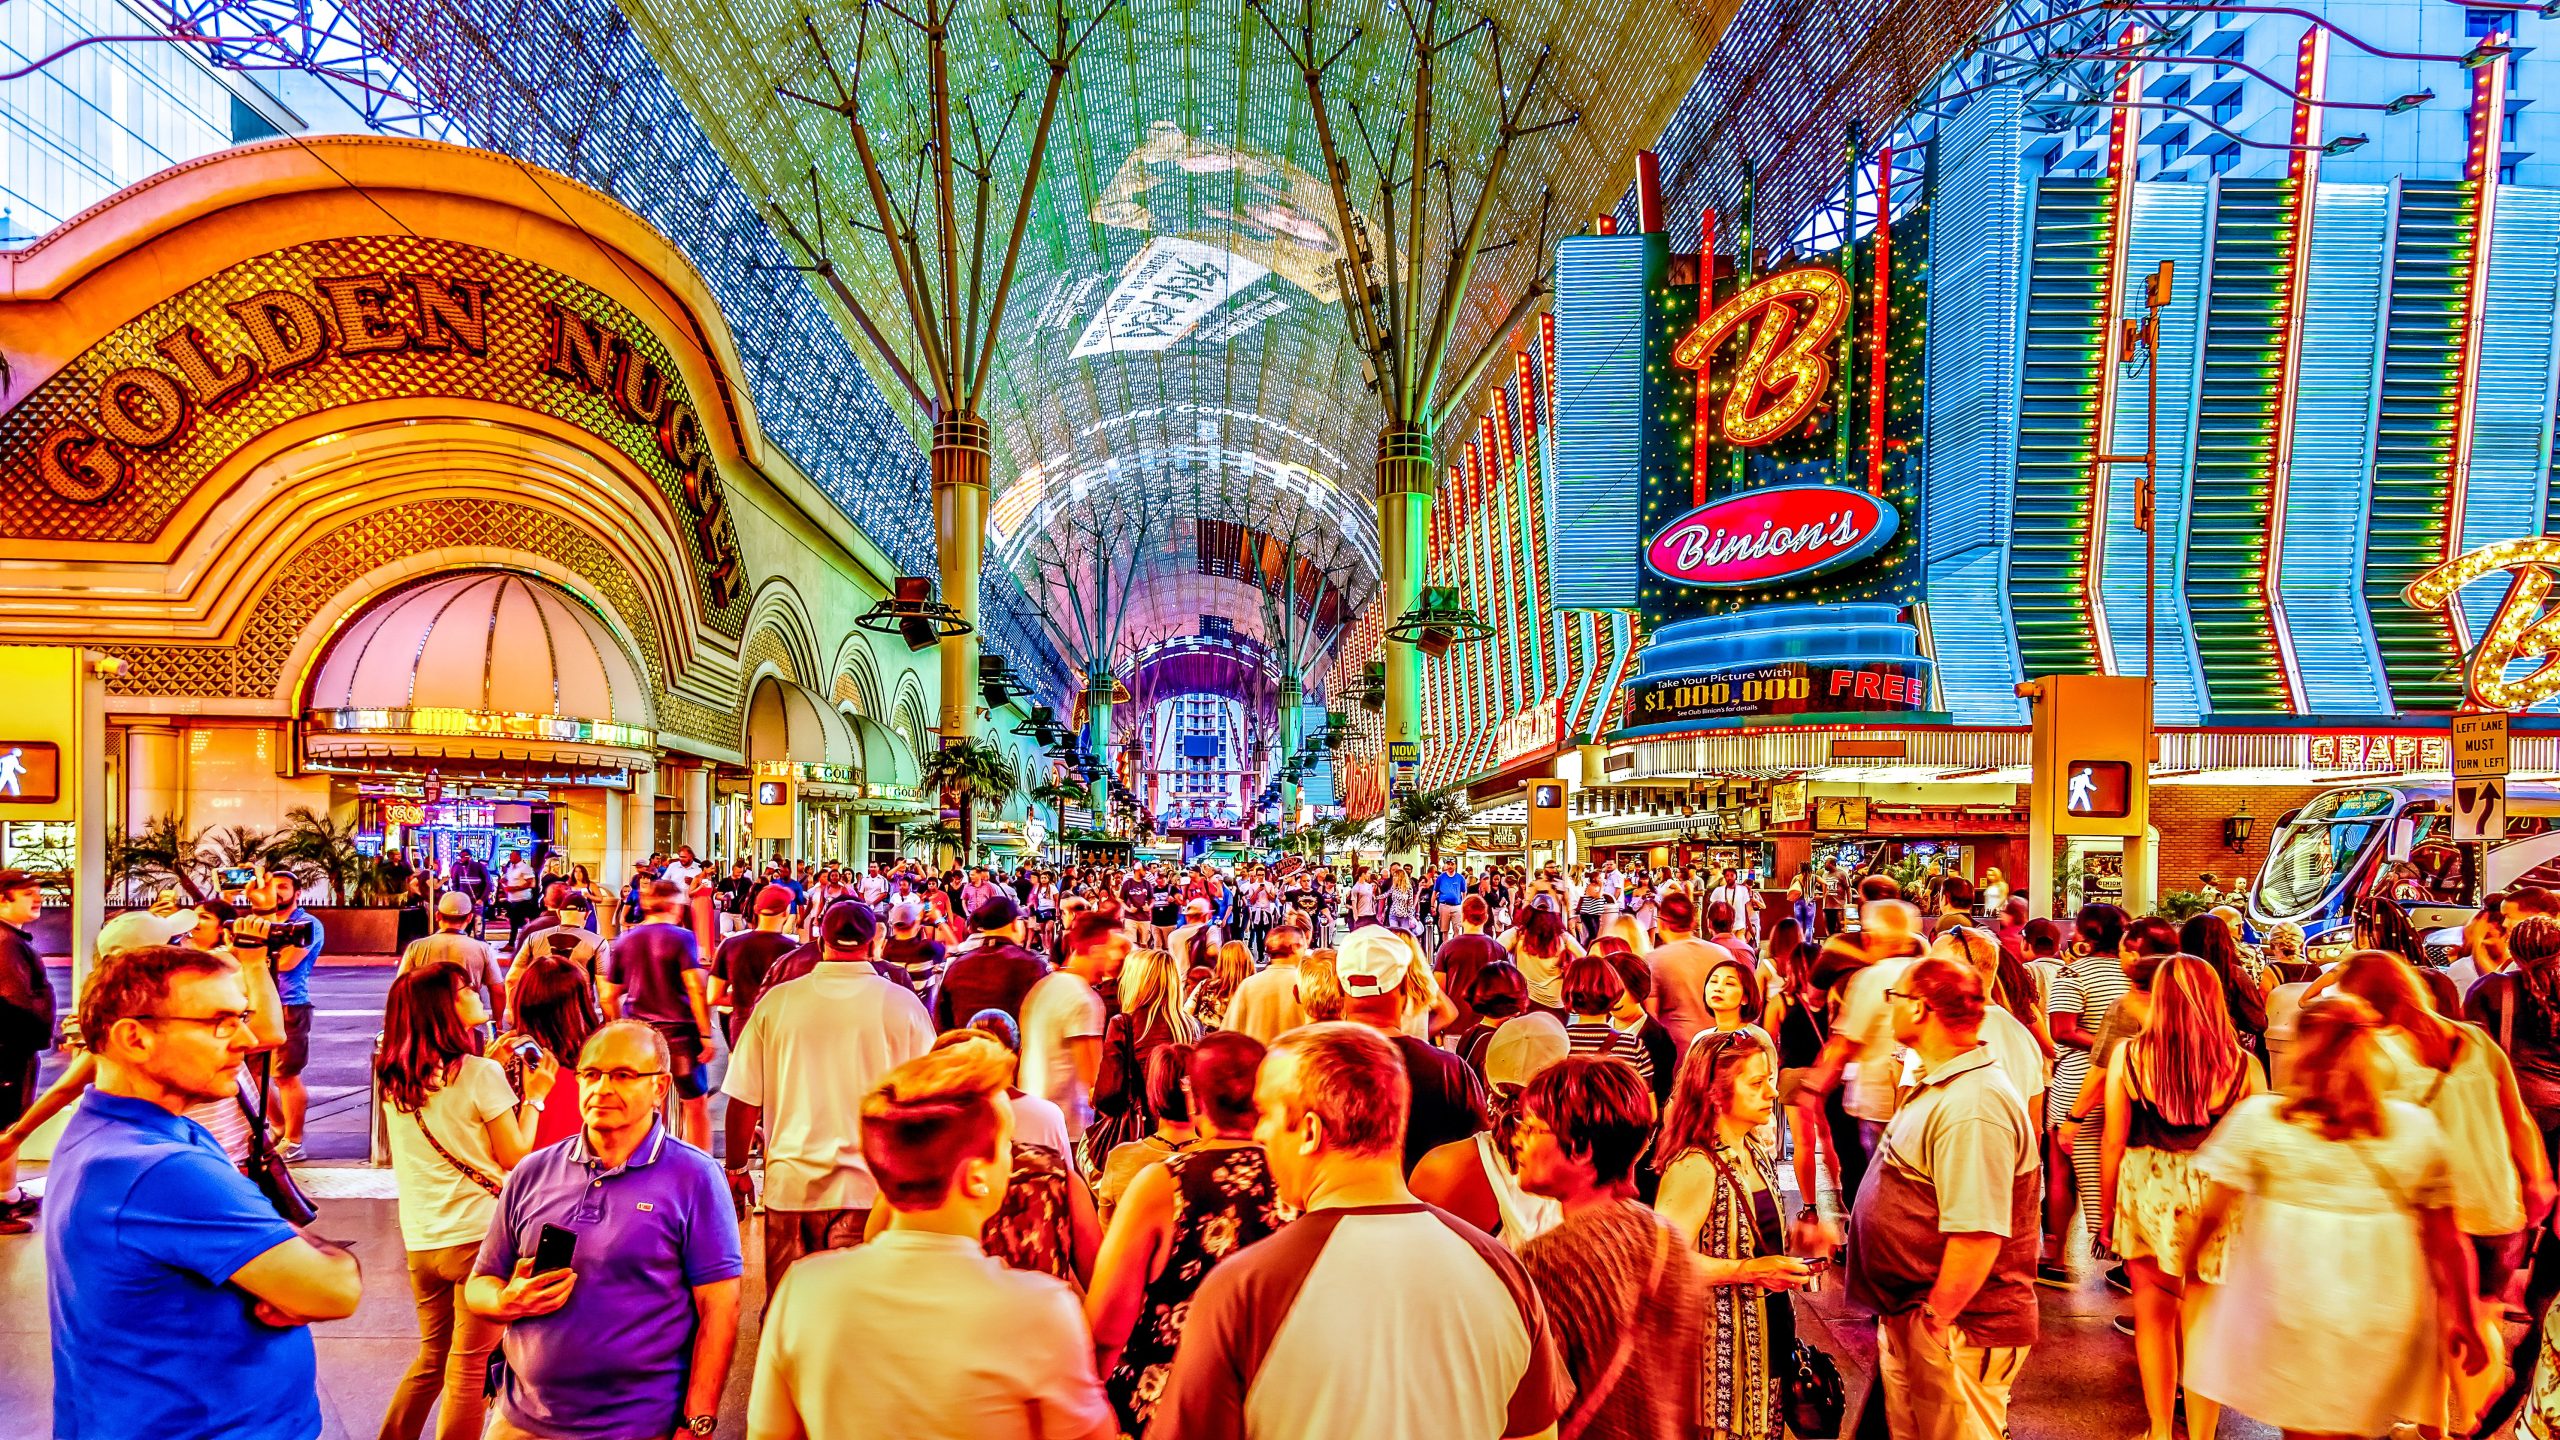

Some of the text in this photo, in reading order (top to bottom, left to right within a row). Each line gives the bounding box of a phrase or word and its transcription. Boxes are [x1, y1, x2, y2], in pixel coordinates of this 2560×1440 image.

[1674, 268, 1853, 447] B
[1082, 407, 1167, 437] Under
[38, 272, 742, 609] GOLDEN NUGGET
[1664, 510, 1860, 572] Binion's
[1656, 668, 1792, 689] Take Your Picture With
[1829, 669, 1922, 706] FREE
[1645, 677, 1810, 713] $1,000,000
[2456, 720, 2503, 734] LEFT LANE
[1391, 745, 1418, 756] NOW
[2311, 737, 2444, 764] CRAPS
[2465, 739, 2494, 752] MUST
[2456, 757, 2505, 769] TURN LEFT
[1494, 834, 1517, 844] POKER
[1497, 826, 1513, 835] LIVE
